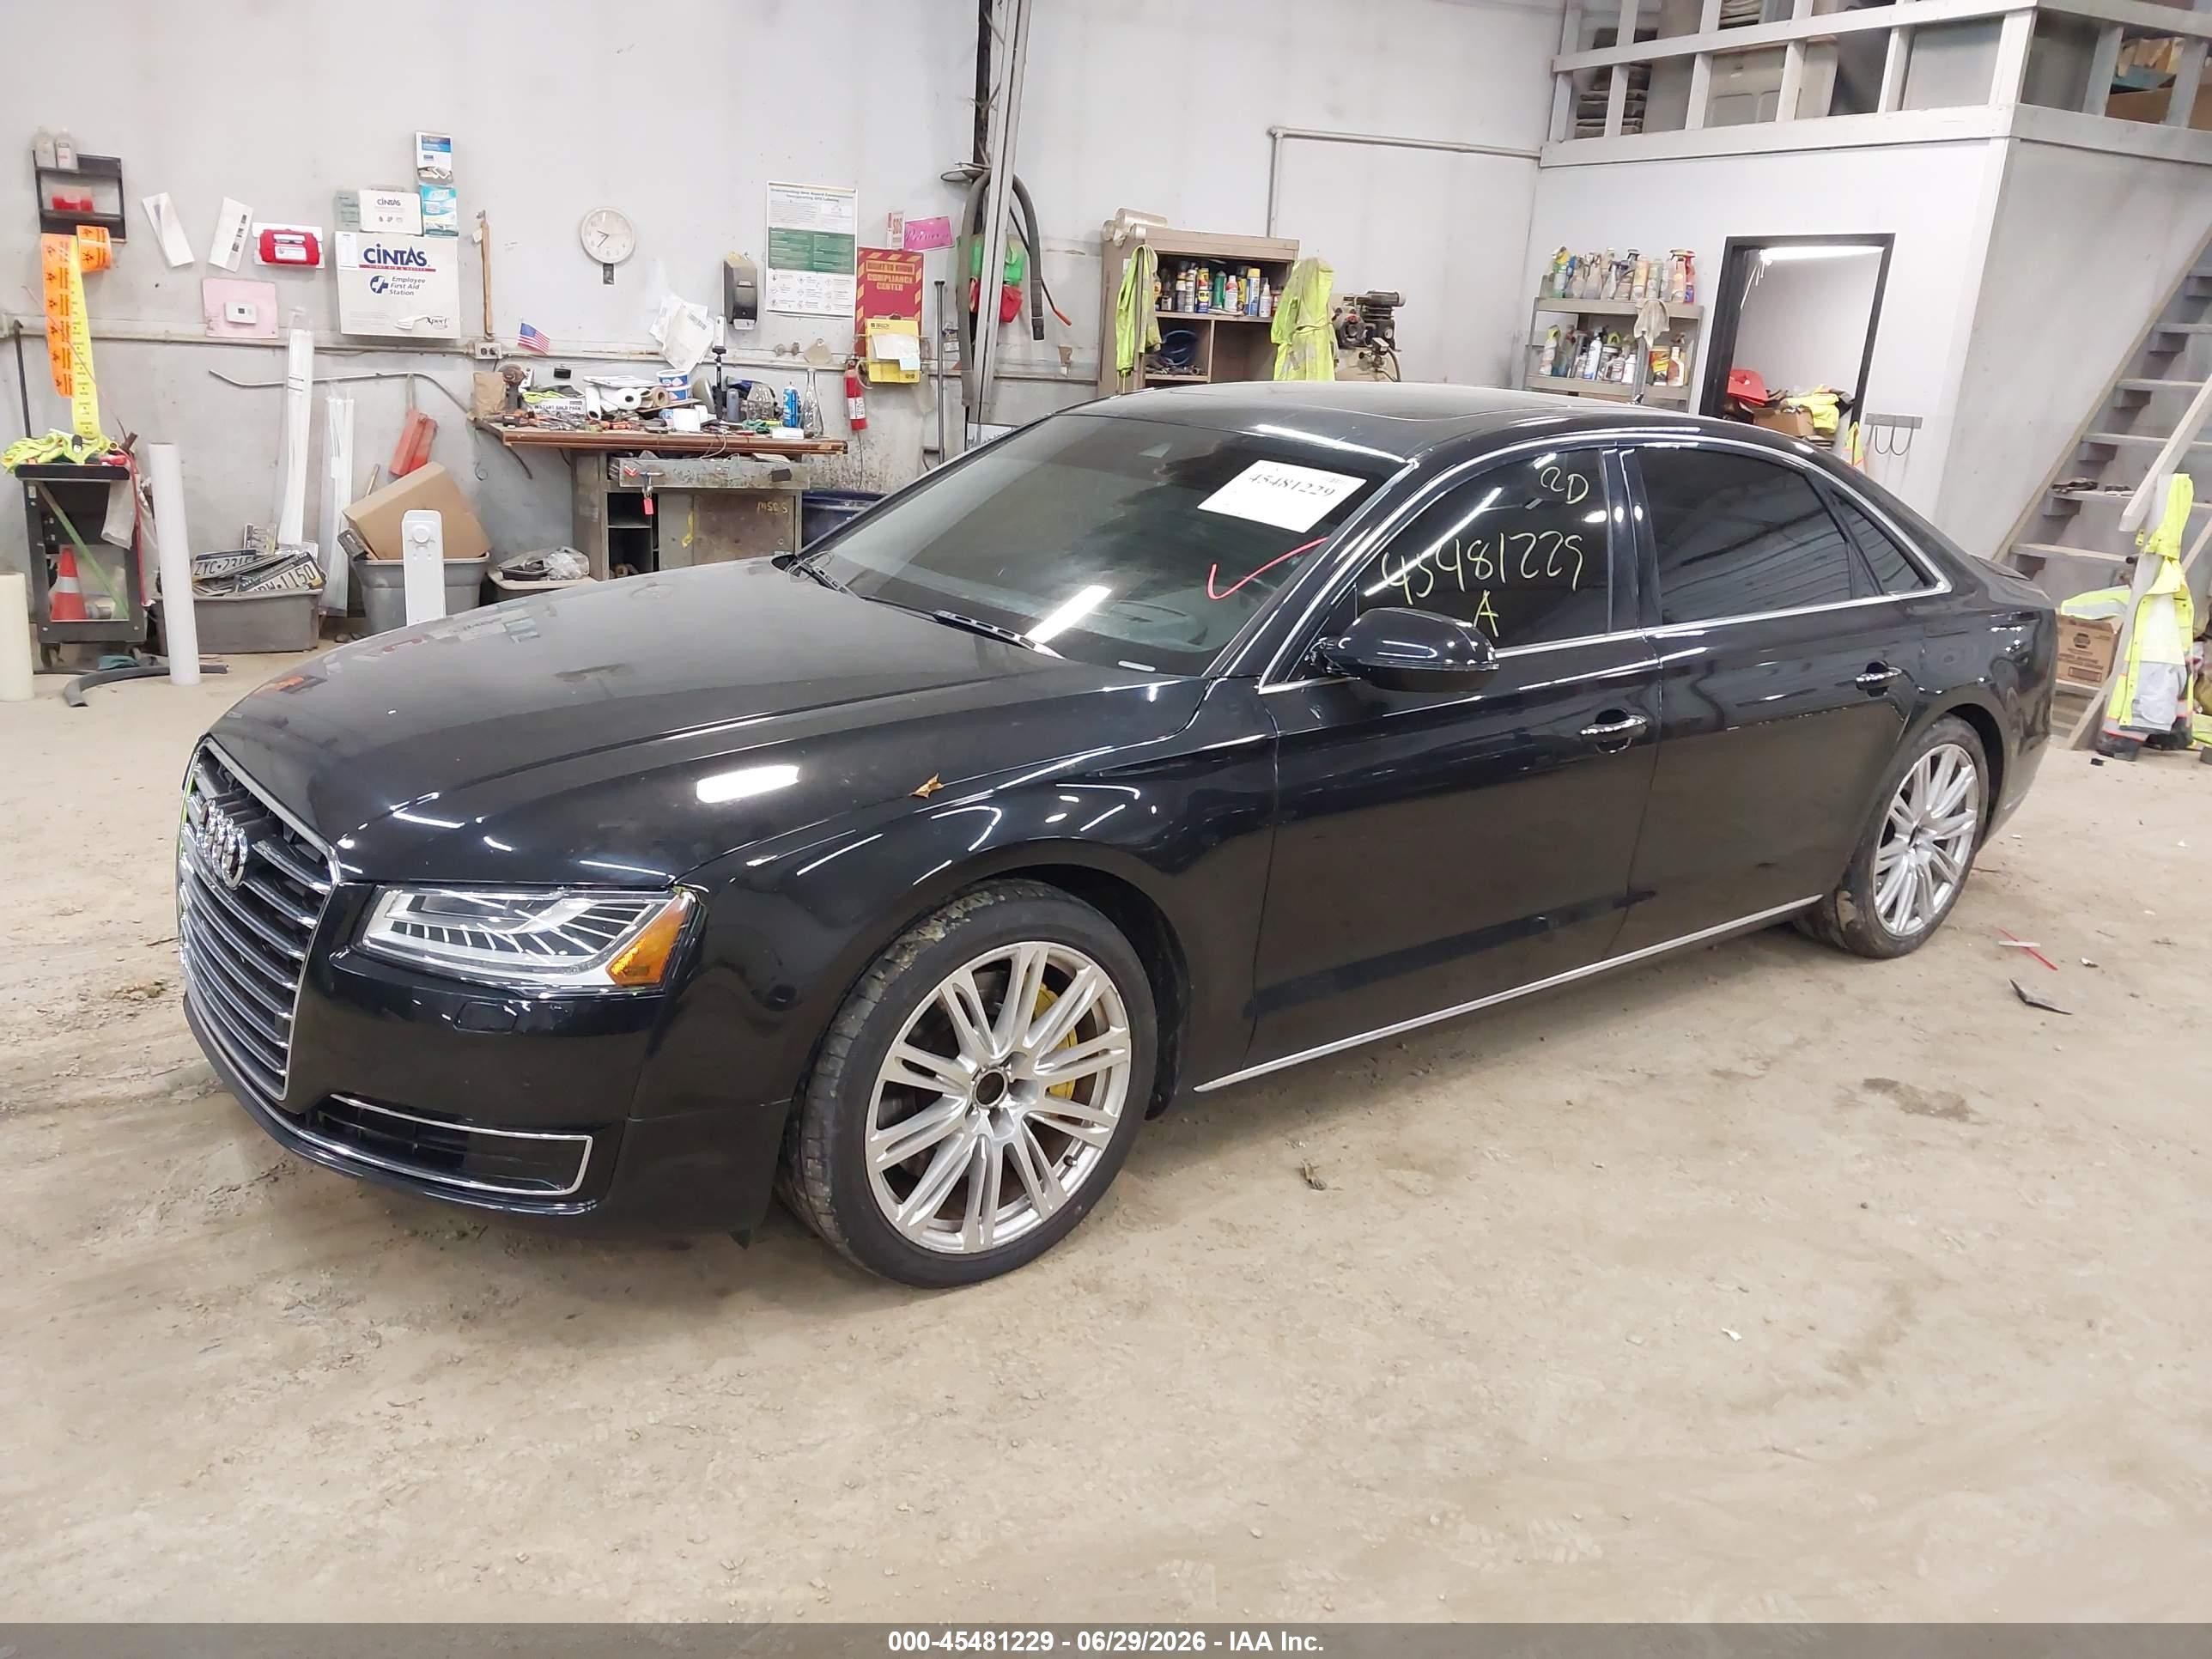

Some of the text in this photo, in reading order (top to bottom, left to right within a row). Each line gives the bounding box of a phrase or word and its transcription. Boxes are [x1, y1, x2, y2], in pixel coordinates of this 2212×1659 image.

[376, 197, 402, 207] CINTAS
[363, 243, 428, 267] CINTAS
[392, 276, 426, 284] Employee
[866, 273, 913, 284] COMPLIANCE
[876, 282, 903, 291] CENTER
[1249, 473, 1336, 497] 45481229
[1381, 530, 1584, 605] 45481229
[1474, 590, 1499, 637] A
